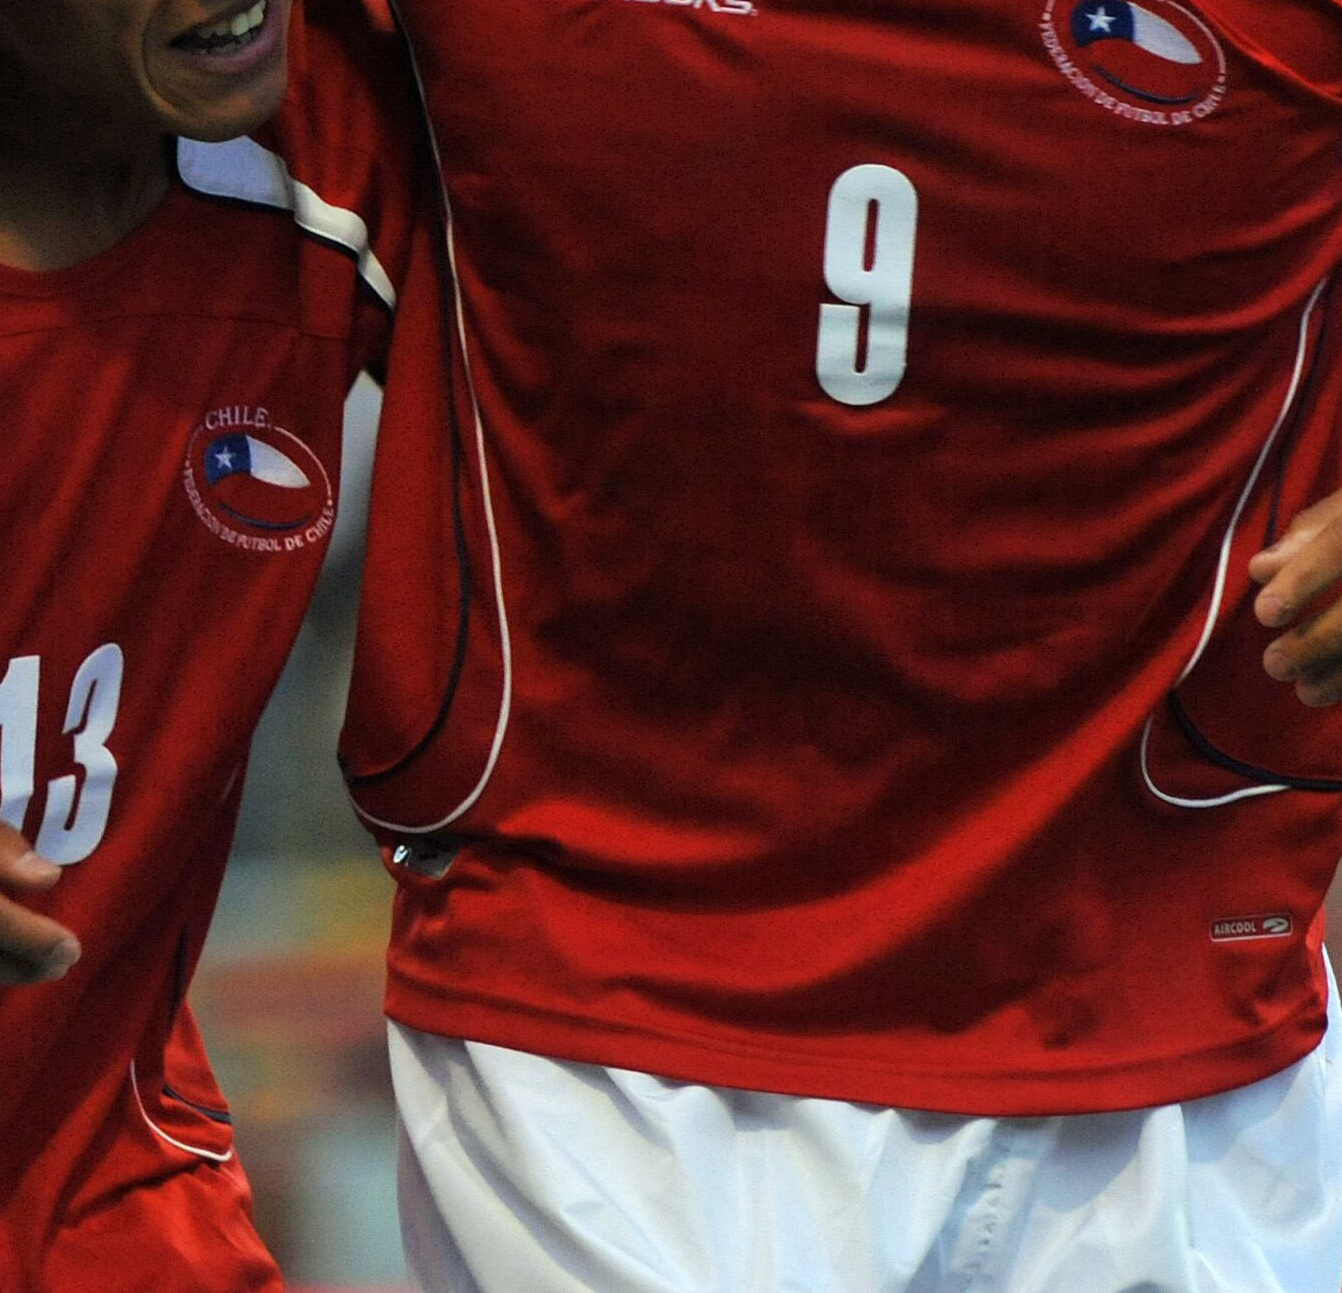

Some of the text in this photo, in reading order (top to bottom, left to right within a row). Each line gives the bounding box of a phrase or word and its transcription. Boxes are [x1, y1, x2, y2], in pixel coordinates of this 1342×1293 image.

[816, 163, 918, 405] 9
[206, 406, 268, 429] CHILE
[1214, 922, 1257, 936] AIRCOOL
